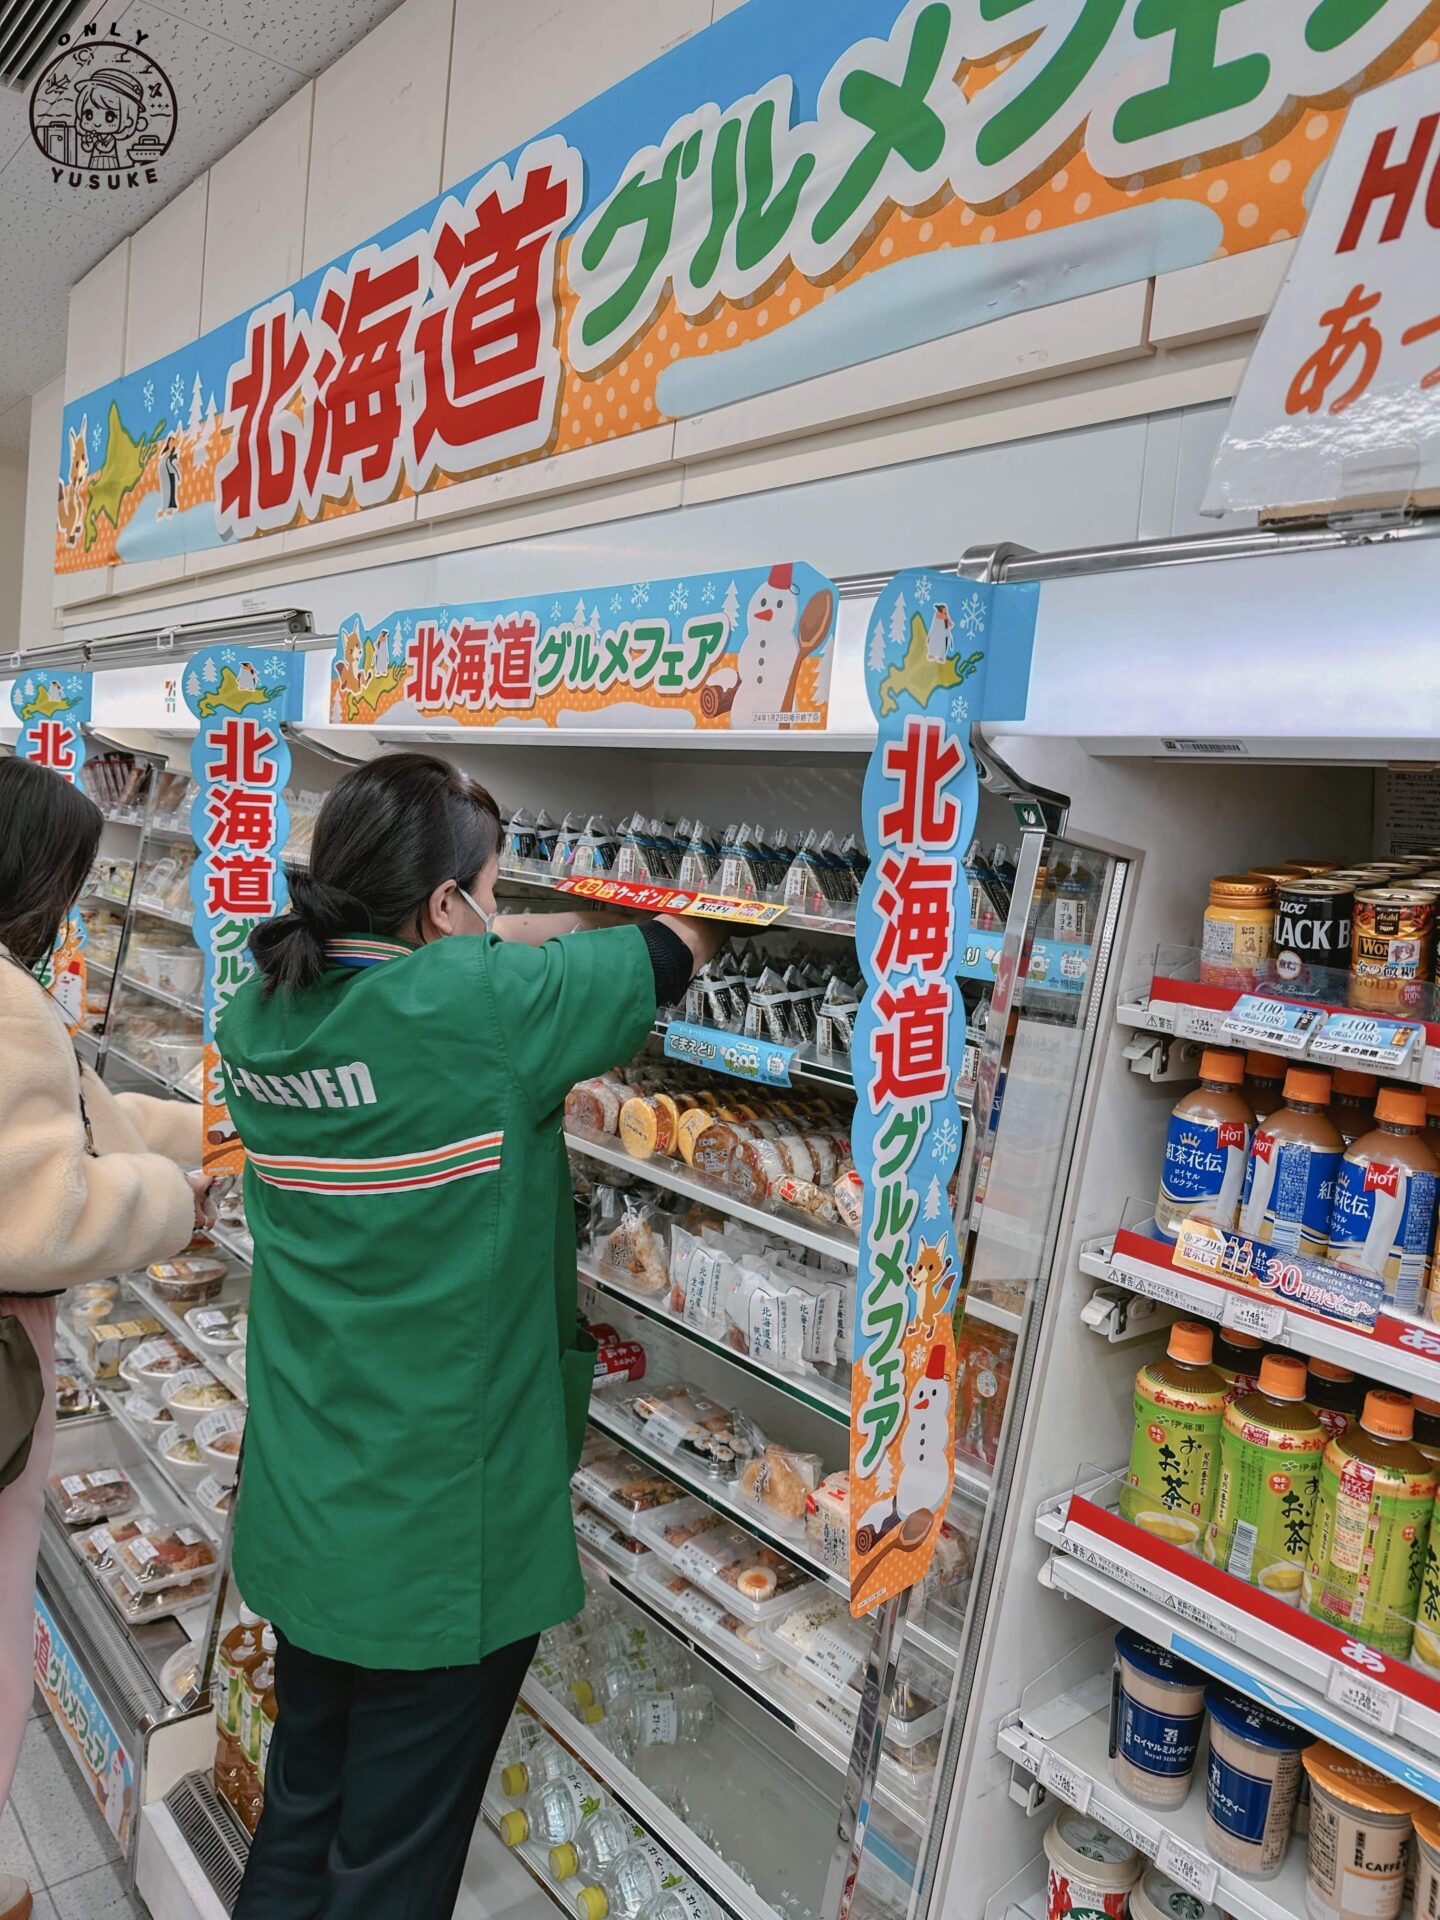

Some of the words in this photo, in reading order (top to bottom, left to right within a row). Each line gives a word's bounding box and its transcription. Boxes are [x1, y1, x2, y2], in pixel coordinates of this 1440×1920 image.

[1335, 112, 1440, 254] H
[407, 620, 724, 702] 北海道グルメフェア
[697, 902, 729, 914] おにぎり
[1280, 901, 1308, 915] UCC
[1274, 912, 1332, 950] LACK
[1224, 1022, 1238, 1031] UCC
[669, 1034, 717, 1059] てまえどり
[1314, 1040, 1341, 1052] ワンダ
[864, 724, 961, 1468] 北海道グルメフェア
[1220, 1128, 1243, 1142] HOT
[1253, 1139, 1271, 1154] HOT
[1166, 1142, 1223, 1172] 紅茶花伝
[1169, 1173, 1207, 1191] ミルクティー
[1367, 1172, 1397, 1187] HOT
[1119, 1272, 1135, 1287] 警告
[761, 1306, 772, 1350] 北海道産
[1171, 1418, 1205, 1433] 伊藤園
[1158, 1443, 1191, 1511] お茶
[1281, 1490, 1313, 1556] お茶
[1072, 1543, 1086, 1559] 警告
[1341, 1640, 1386, 1673] あ
[1134, 1734, 1196, 1755] ロイヤルミルクティー
[1144, 1750, 1162, 1761] Royal
